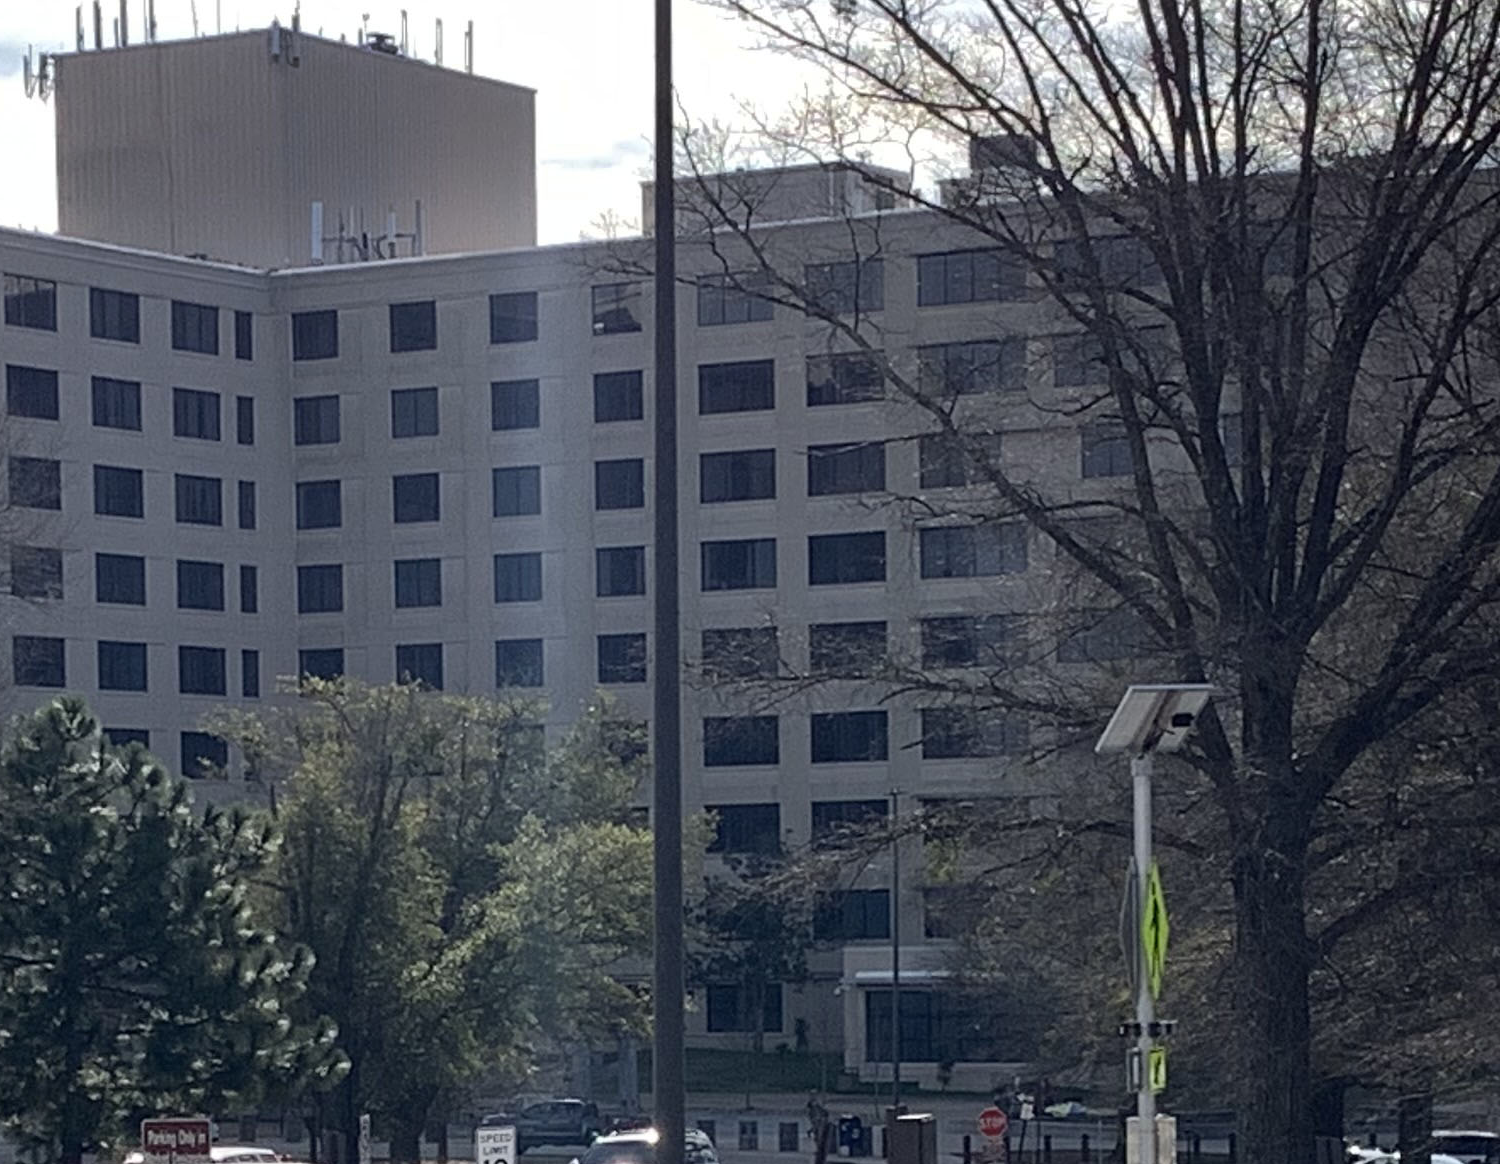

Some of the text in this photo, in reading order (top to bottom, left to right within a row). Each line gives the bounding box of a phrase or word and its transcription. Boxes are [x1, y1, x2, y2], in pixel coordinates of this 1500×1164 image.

[147, 1130, 177, 1148] Parking
[178, 1128, 195, 1148] Only
[480, 1133, 513, 1143] SPEED
[482, 1146, 509, 1156] LIMIT
